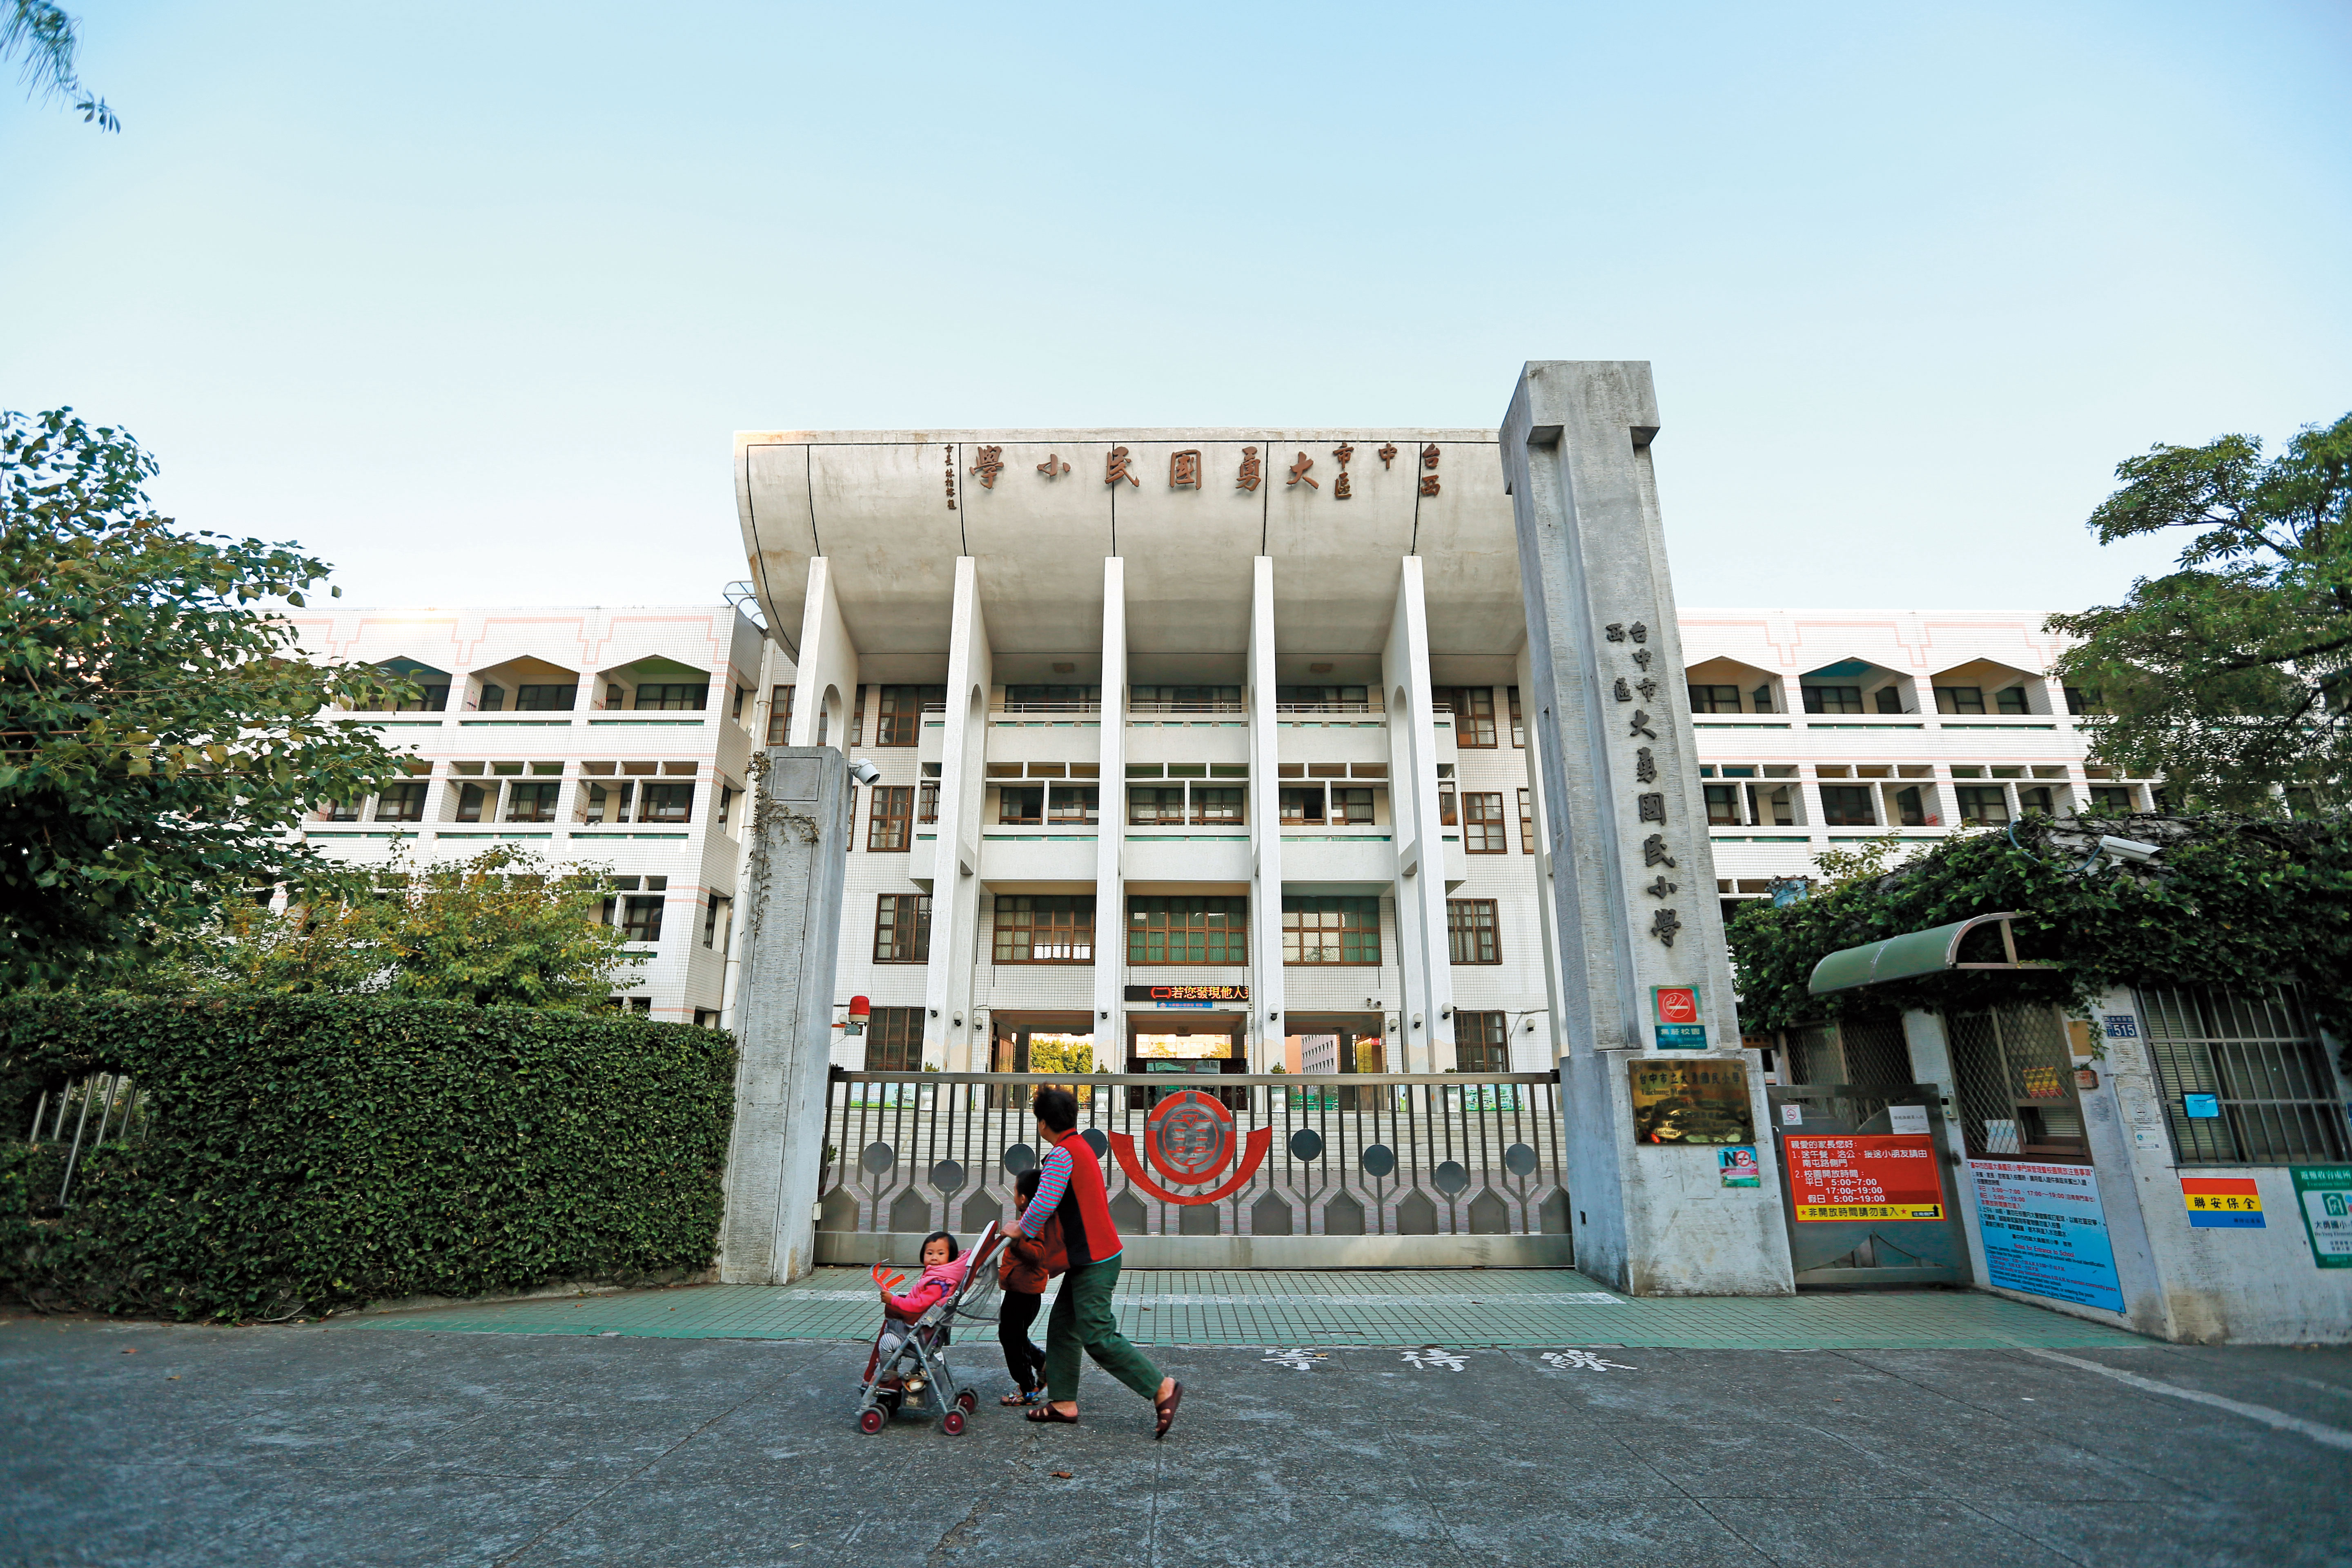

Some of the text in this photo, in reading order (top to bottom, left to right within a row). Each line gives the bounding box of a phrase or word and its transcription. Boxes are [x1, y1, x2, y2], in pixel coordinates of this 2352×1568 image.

[969, 445, 1319, 492] 大勇國民小學
[1606, 622, 1633, 702] 西區
[1630, 620, 1657, 702] 台中市
[1630, 709, 1682, 947] 大勇國民小學
[2114, 1025, 2136, 1036] 515
[1642, 1088, 1670, 1096] Taichung
[1805, 1178, 1823, 1187] 平日
[1807, 1195, 1826, 1203] 假日
[2194, 1197, 2255, 1209] 聯安保全
[1809, 1207, 1899, 1217] 非開放時間請勿進入
